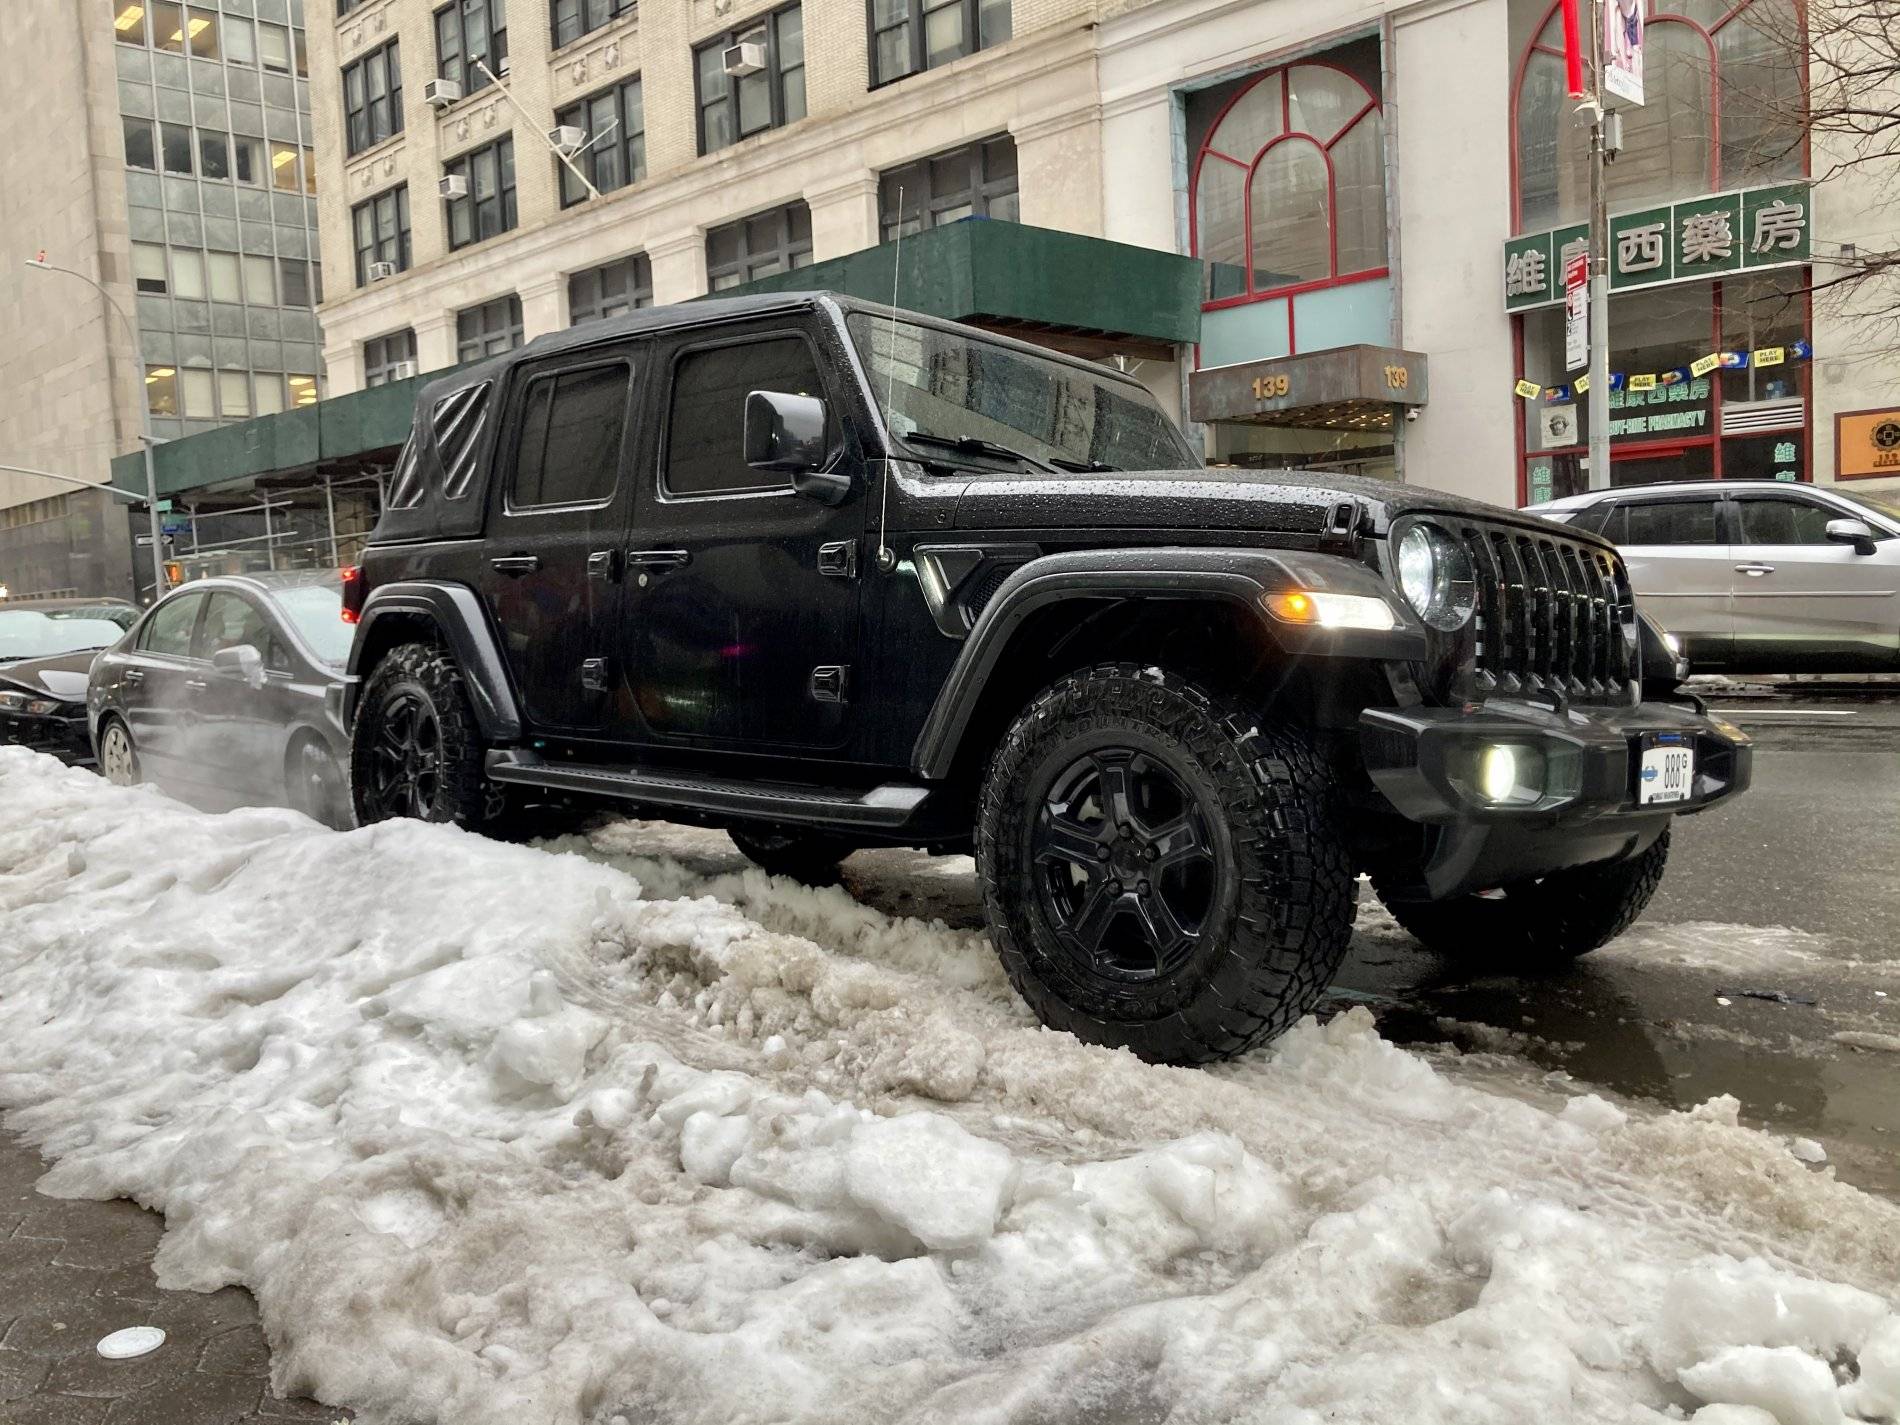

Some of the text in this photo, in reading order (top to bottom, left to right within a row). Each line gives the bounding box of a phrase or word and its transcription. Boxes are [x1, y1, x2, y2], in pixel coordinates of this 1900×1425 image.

[1252, 374, 1289, 400] 139
[1384, 365, 1408, 389] 139
[1665, 753, 1681, 789] 888
